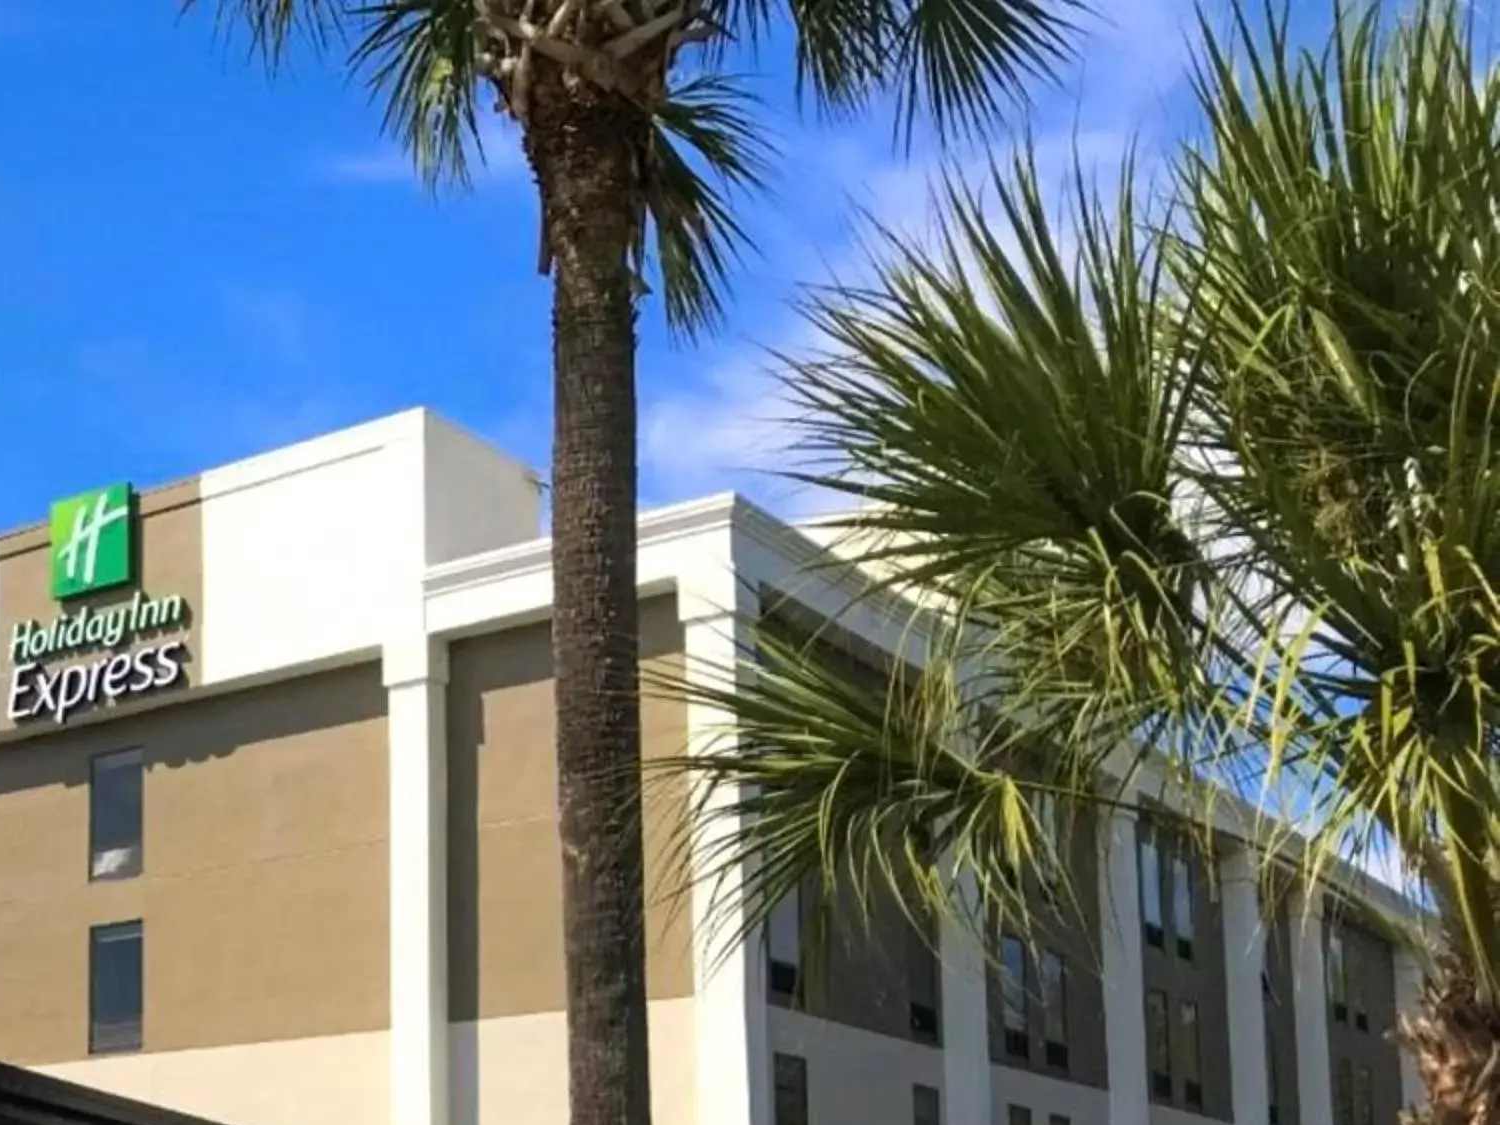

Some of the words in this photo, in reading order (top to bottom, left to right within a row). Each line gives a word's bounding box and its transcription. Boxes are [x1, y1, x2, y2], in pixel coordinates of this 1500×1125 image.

[9, 605, 126, 660] Holiday
[130, 591, 181, 632] Inn
[7, 641, 181, 724] Express
